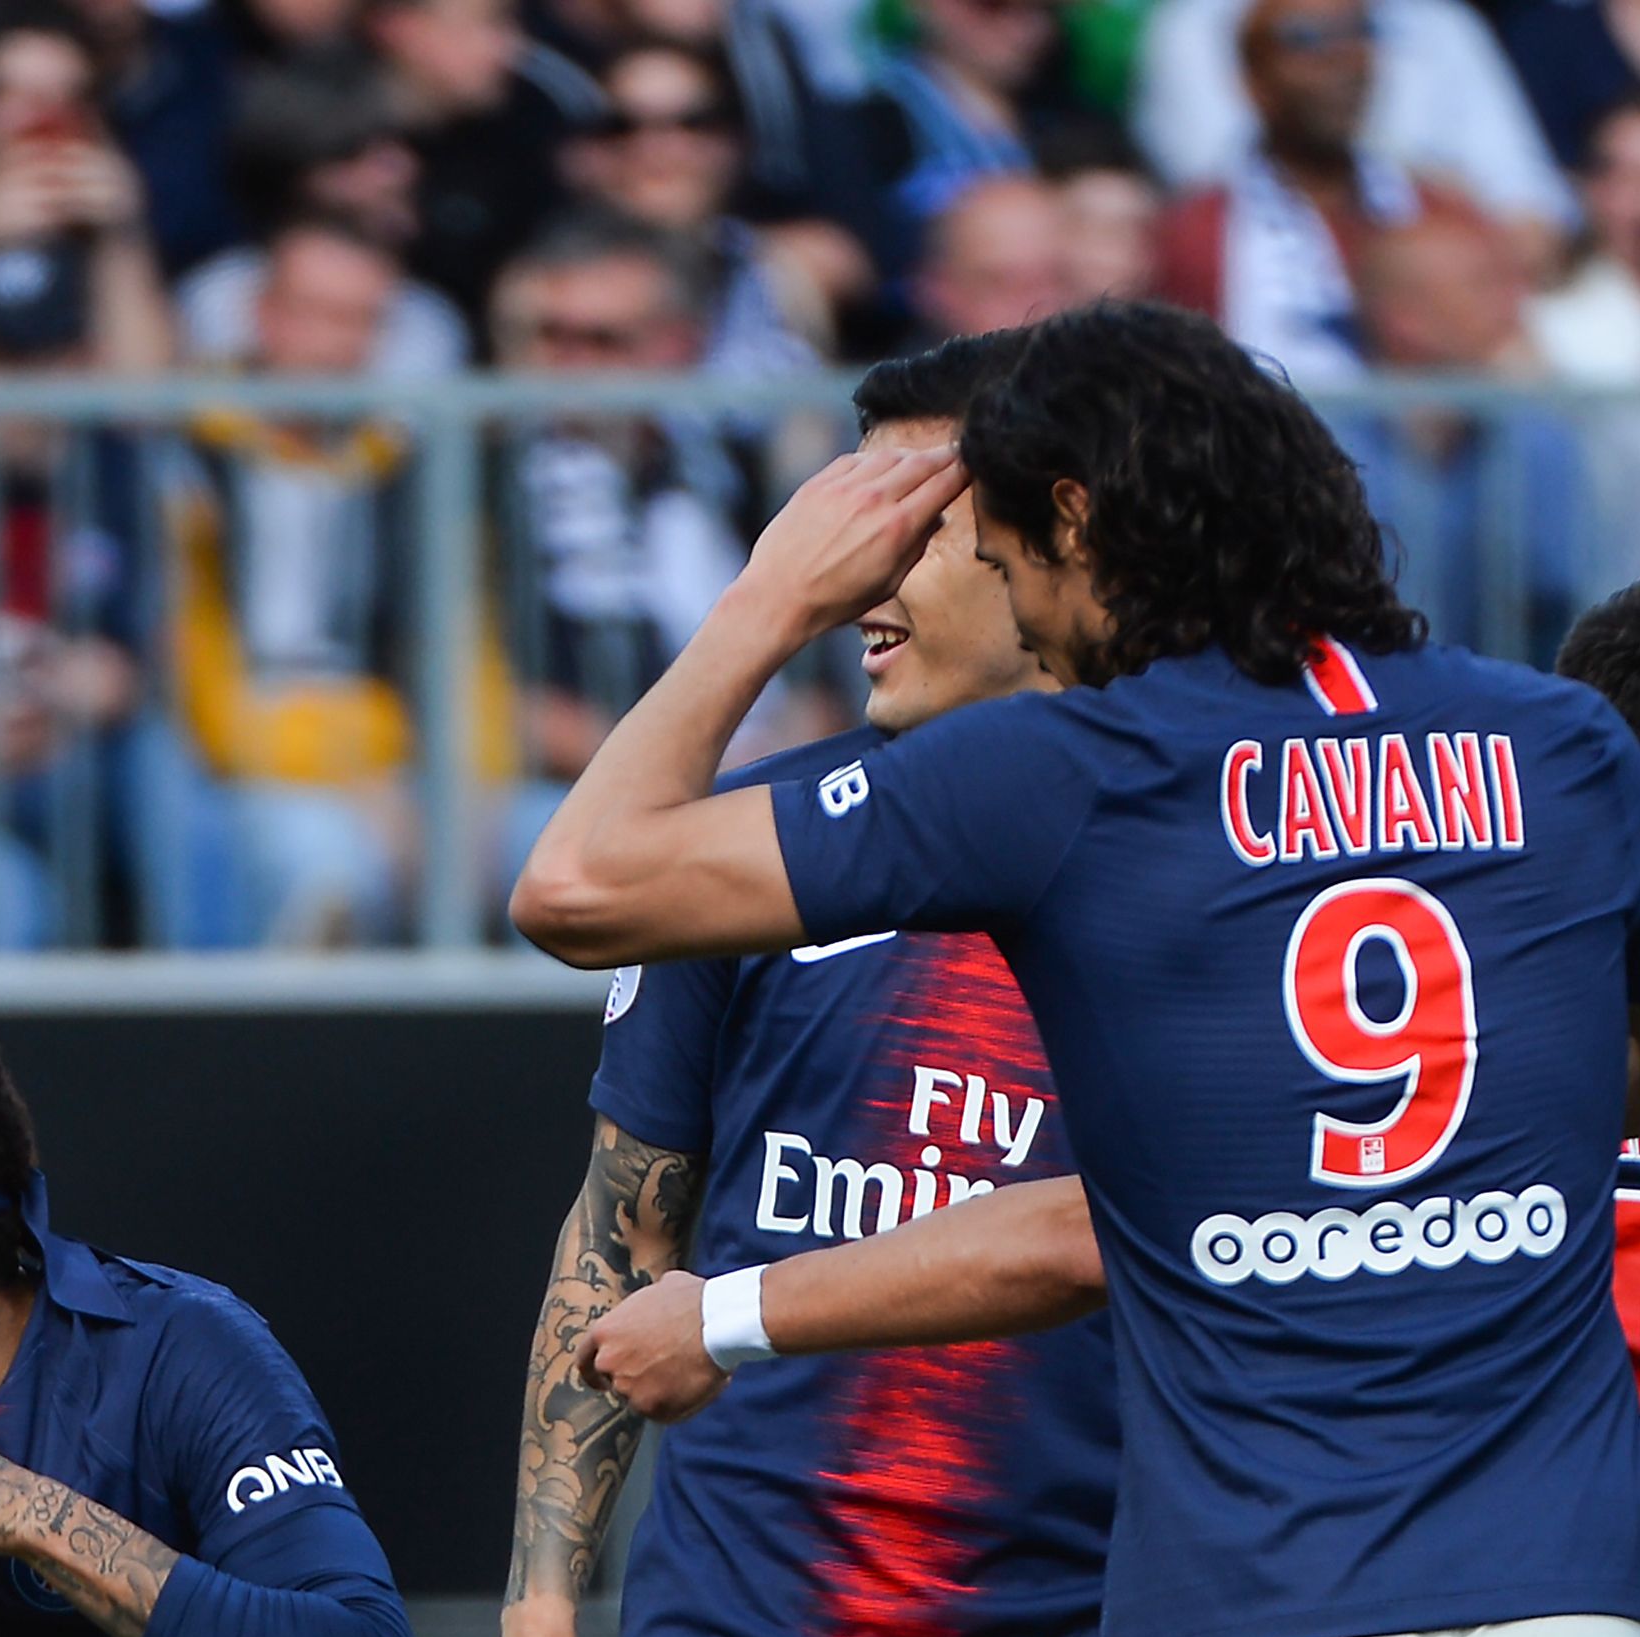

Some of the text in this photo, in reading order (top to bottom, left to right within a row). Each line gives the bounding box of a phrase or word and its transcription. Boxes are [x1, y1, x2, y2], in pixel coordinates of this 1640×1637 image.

[1221, 732, 1524, 866] CAVANI
[1284, 877, 1478, 1187] 9
[908, 1065, 1045, 1167] Fly
[1190, 1183, 1567, 1287] ooredoo
[227, 1448, 344, 1513] QNB
